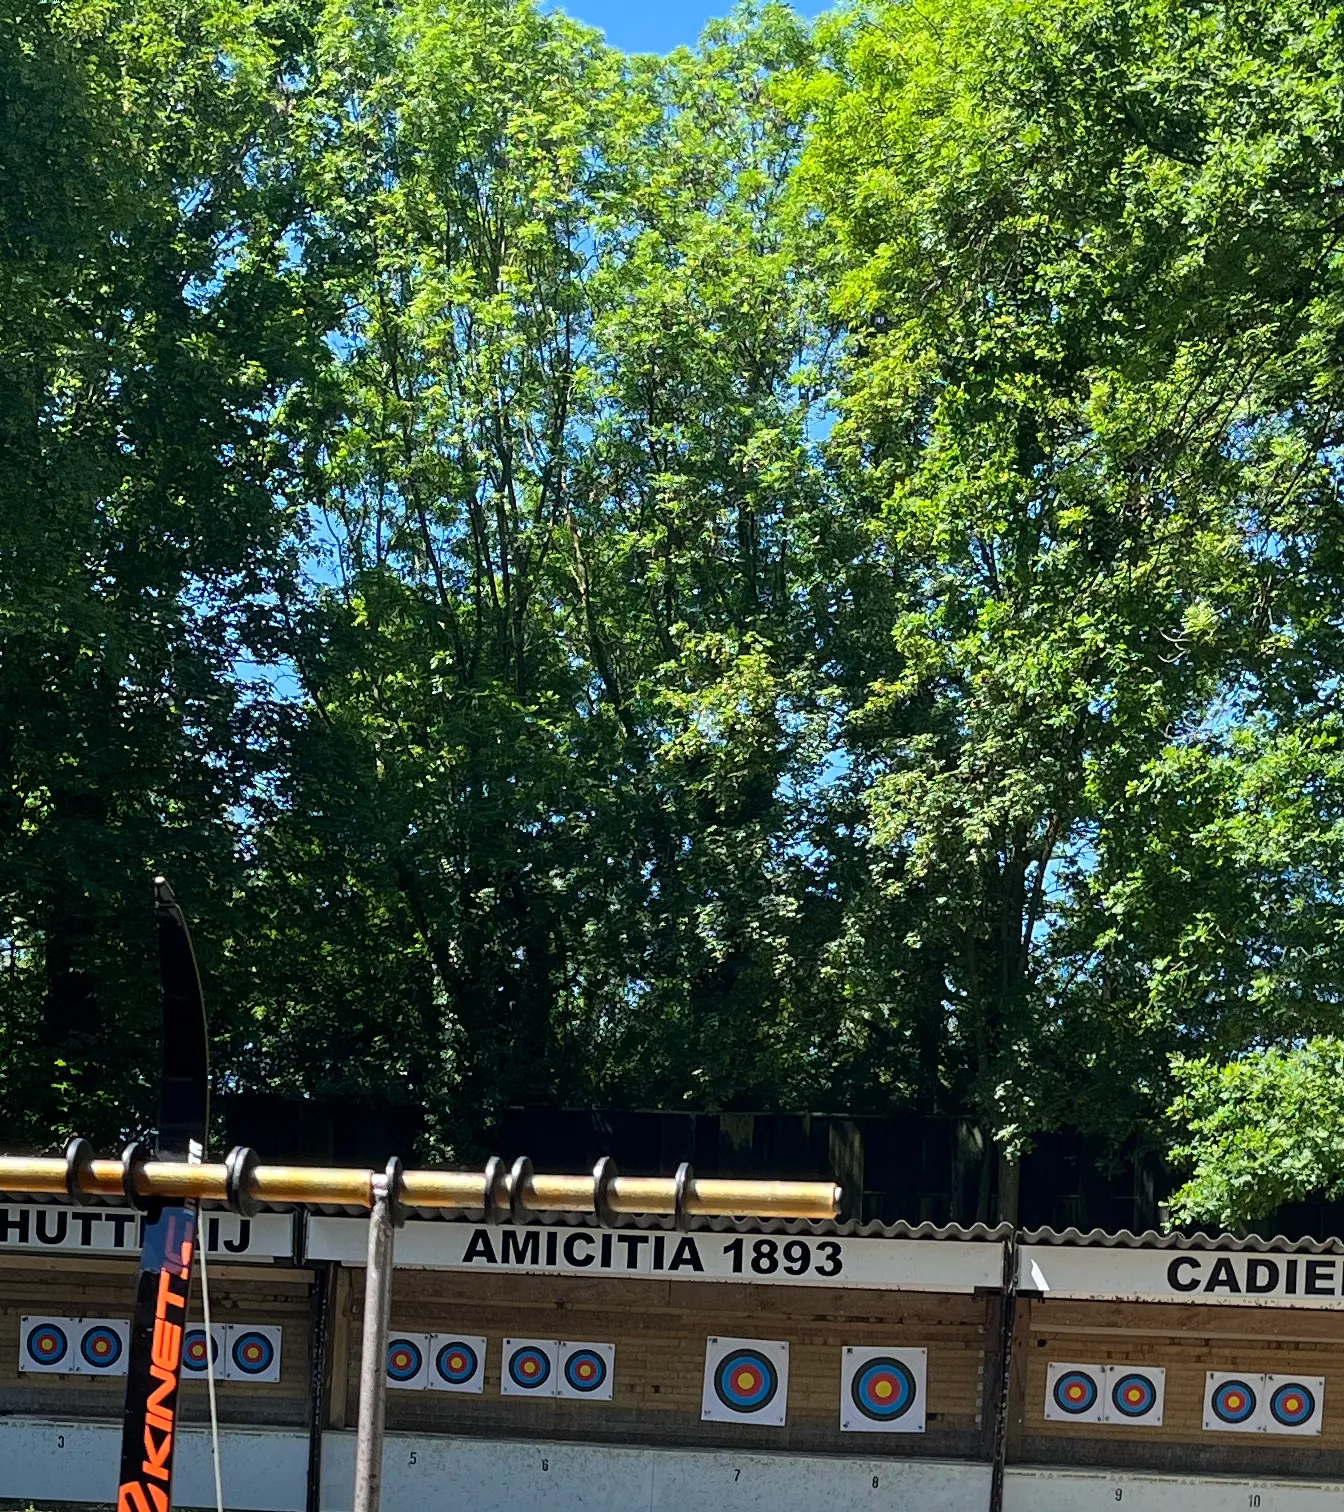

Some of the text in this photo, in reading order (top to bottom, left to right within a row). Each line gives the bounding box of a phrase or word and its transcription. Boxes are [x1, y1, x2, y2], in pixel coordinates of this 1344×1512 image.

[463, 1228, 844, 1278] AMICITIA 1893
[57, 1435, 65, 1448] 3
[409, 1451, 417, 1465] 5
[541, 1458, 549, 1471] 6
[734, 1469, 741, 1481] 7
[872, 1476, 879, 1488] 8
[1115, 1488, 1123, 1501] 9
[1248, 1494, 1261, 1508] 10
